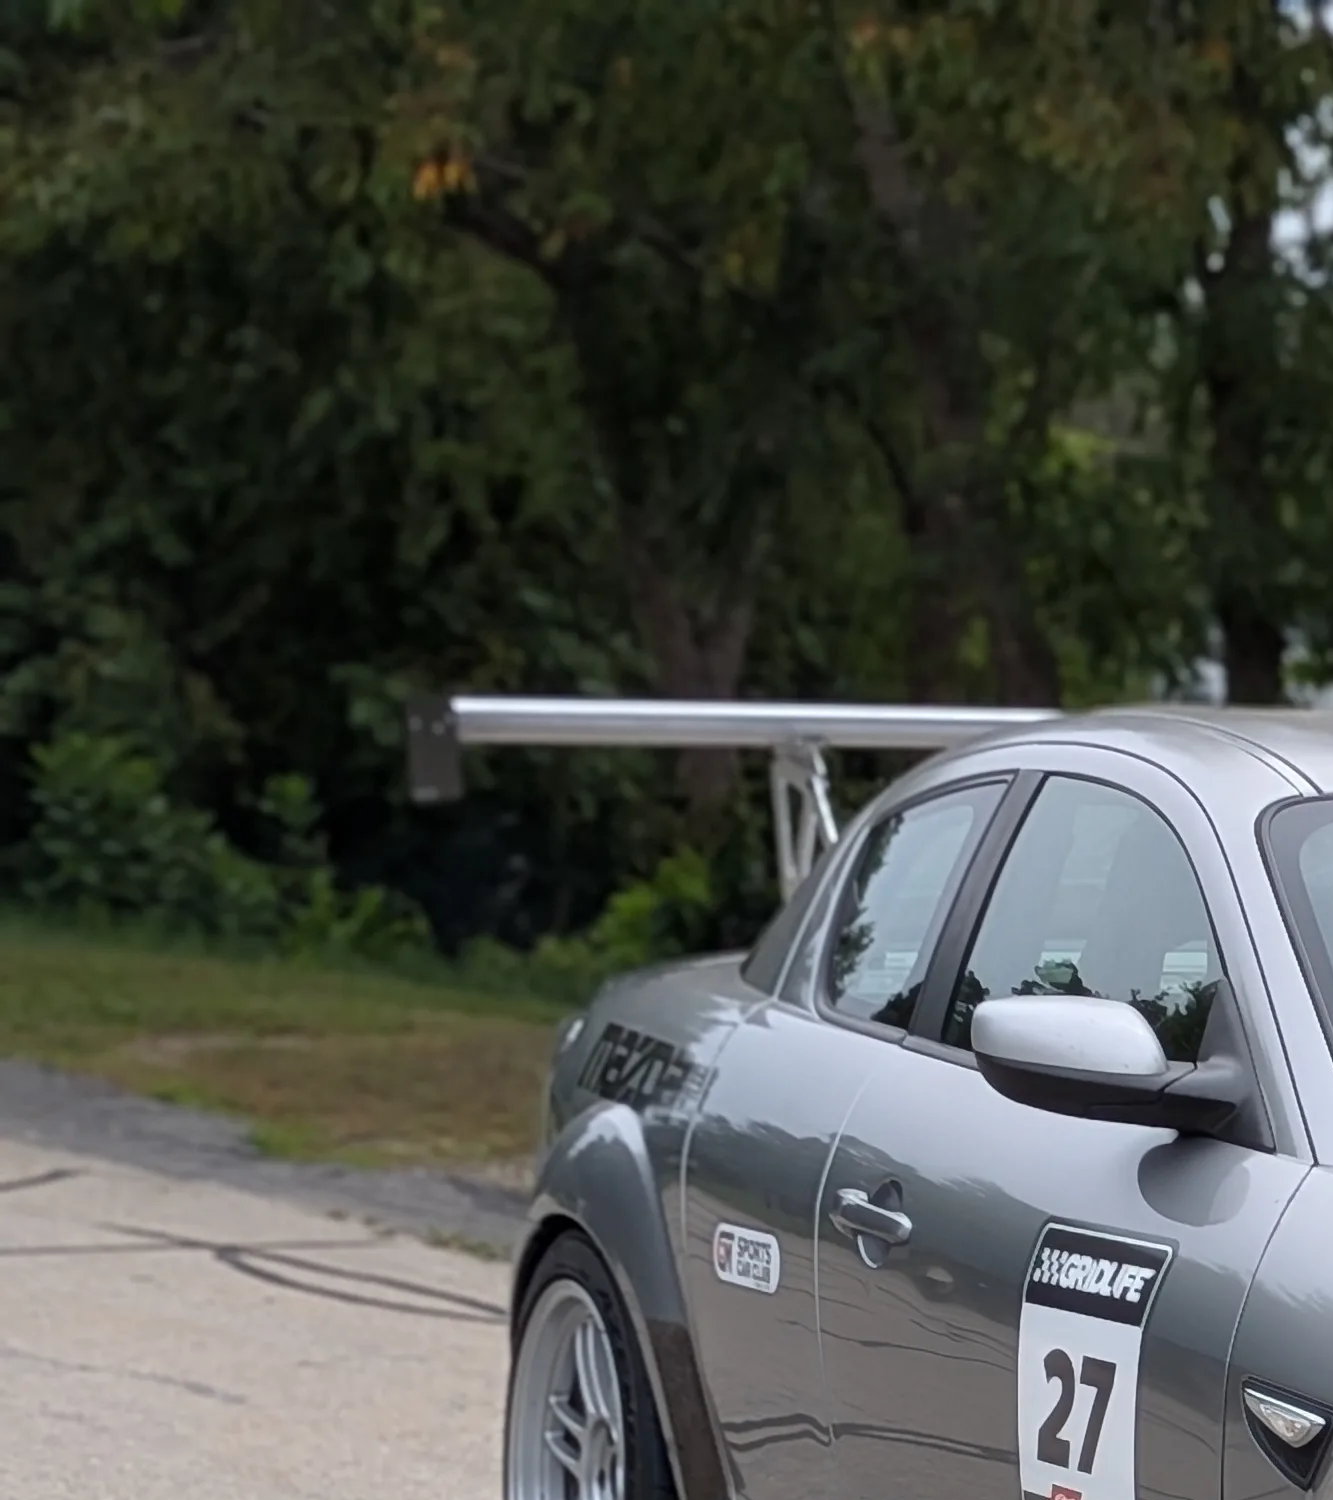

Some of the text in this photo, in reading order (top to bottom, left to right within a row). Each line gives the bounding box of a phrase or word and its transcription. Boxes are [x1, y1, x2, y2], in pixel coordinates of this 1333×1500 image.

[737, 1237, 772, 1264] SPORTS
[1060, 1253, 1156, 1303] GRIDLIFE
[1037, 1348, 1117, 1475] 27
